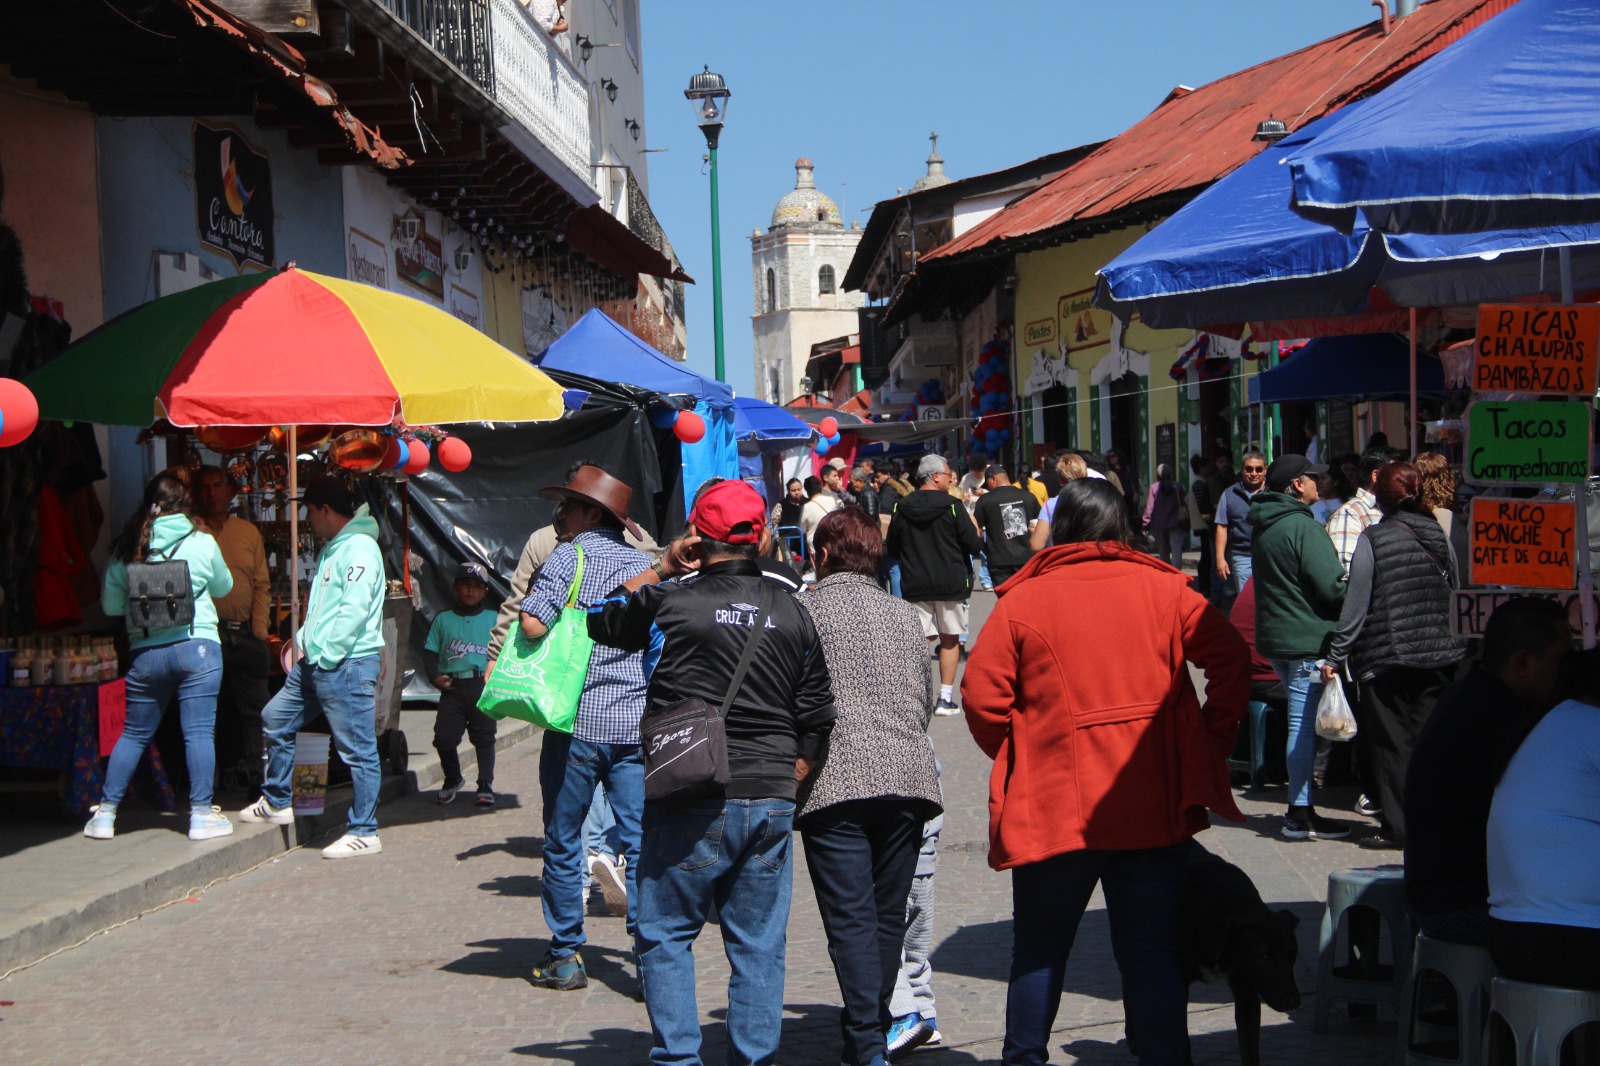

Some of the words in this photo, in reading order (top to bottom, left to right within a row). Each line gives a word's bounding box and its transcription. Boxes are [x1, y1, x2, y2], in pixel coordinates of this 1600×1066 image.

[1028, 325, 1052, 341] Pastes
[1497, 310, 1579, 341] RICAS
[1479, 335, 1584, 362] CHALUPAS
[1477, 364, 1584, 391] PAMBAZOS
[1486, 408, 1567, 439] Tacos
[1470, 446, 1587, 481] Campechanos
[1498, 503, 1545, 525] RICO
[1474, 521, 1542, 546] PONCHE
[1553, 527, 1572, 549] Y
[1515, 548, 1529, 564] DE
[1538, 550, 1570, 567] OLLA
[347, 566, 366, 582] 27
[715, 609, 742, 625] CRUZ
[747, 612, 776, 628] AL
[505, 666, 526, 676] ANITA
[649, 726, 693, 755] Sport
